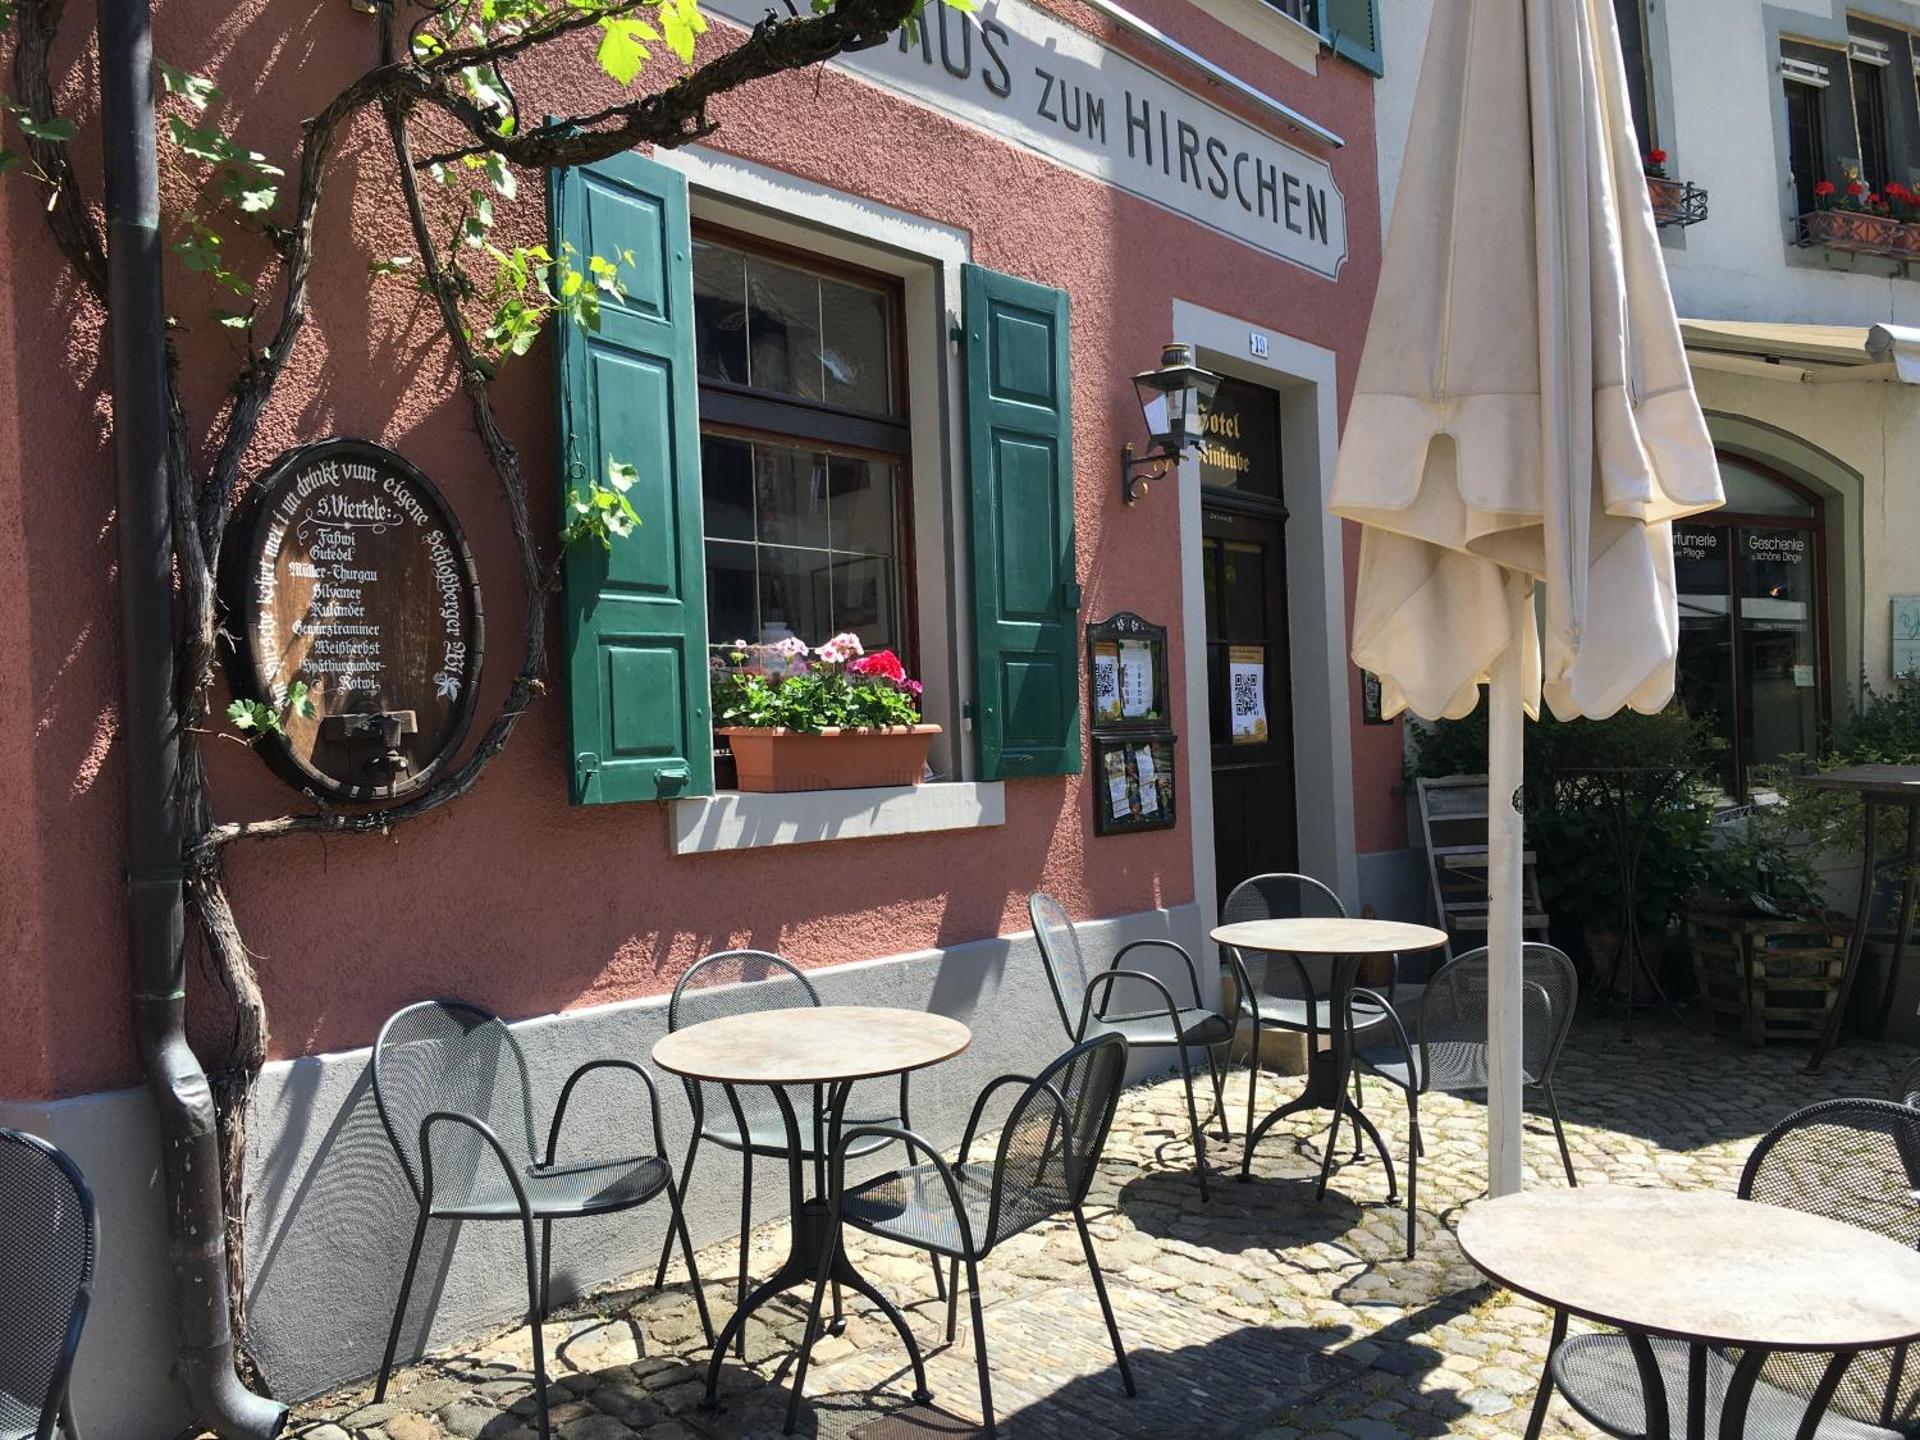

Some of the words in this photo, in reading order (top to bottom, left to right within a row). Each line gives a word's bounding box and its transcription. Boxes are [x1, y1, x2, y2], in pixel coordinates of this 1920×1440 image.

[1035, 67, 1106, 144] ZUM
[1125, 90, 1328, 246] HIRSCHEN
[1255, 335, 1266, 355] 19
[1199, 444, 1249, 472] einstube
[264, 522, 286, 558] mer
[296, 460, 341, 498] drinkt
[341, 462, 378, 482] vum
[382, 478, 429, 526] eigene
[309, 545, 356, 561] Gutedel
[1749, 536, 1804, 551] Geschenke
[288, 561, 377, 584] Müller-Thurgau
[311, 581, 361, 599] Silvaner
[310, 600, 365, 618] Ruländer
[292, 620, 380, 638] Gewürztraminer
[314, 638, 380, 658] Weißherbst
